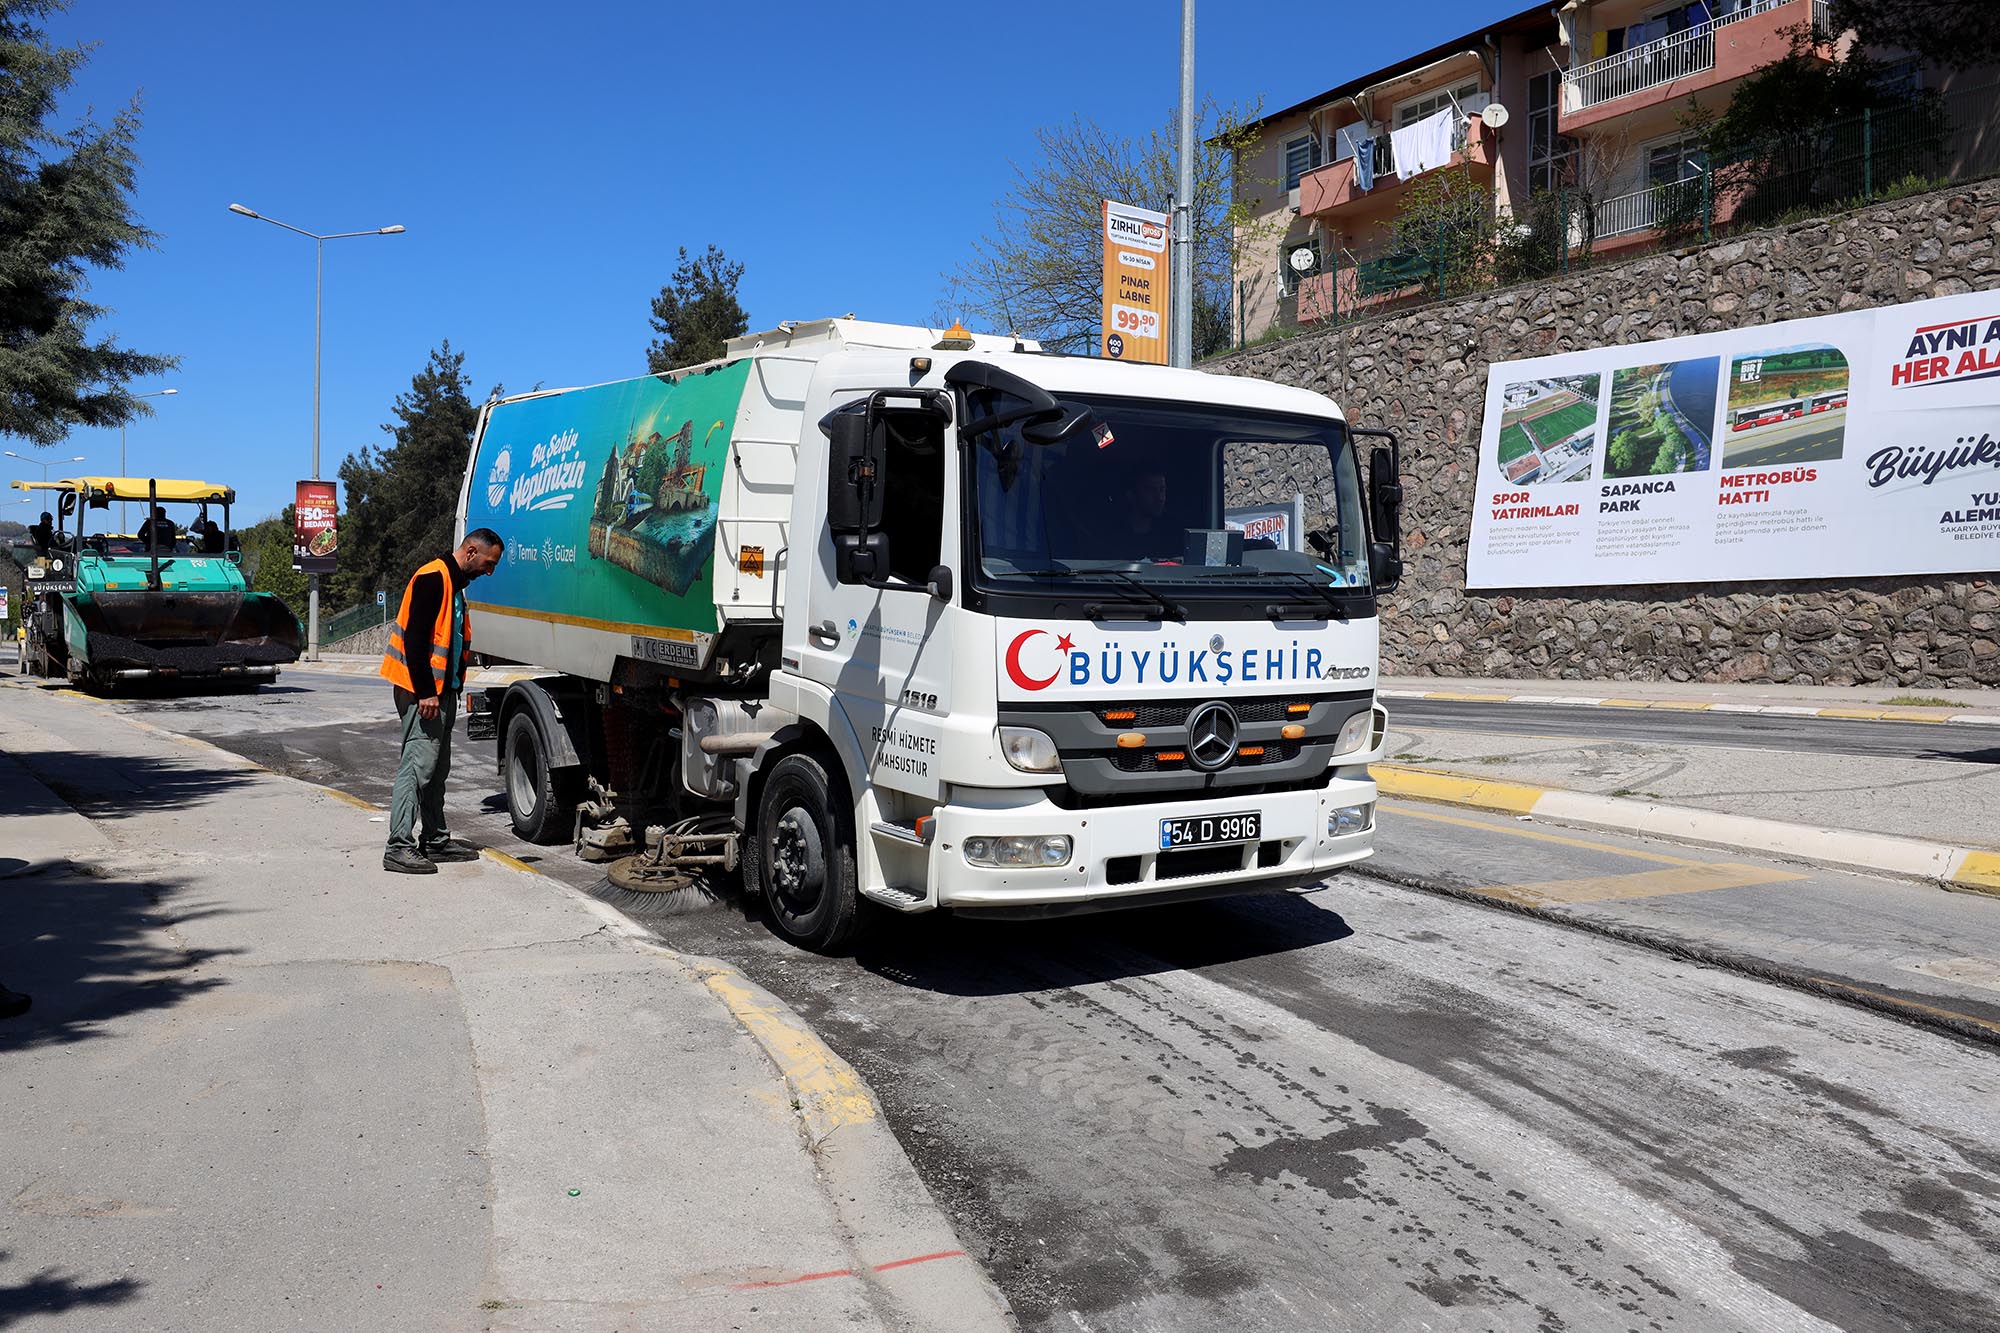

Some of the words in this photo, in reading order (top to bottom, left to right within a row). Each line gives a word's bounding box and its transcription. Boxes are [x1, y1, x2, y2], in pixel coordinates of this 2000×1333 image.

[1111, 218, 1141, 235] ZIRHLI
[1121, 275, 1150, 290] PINAR
[1120, 289, 1150, 304] LABNE
[1109, 339, 1122, 348] 400
[1905, 324, 1978, 358] AYNI
[1110, 346, 1120, 354] GR
[1892, 356, 1950, 386] HER
[1954, 348, 2000, 374] AL
[530, 443, 547, 468] Bu
[546, 428, 578, 466] Şehir
[510, 450, 586, 516] Hepimizin
[1720, 467, 1817, 488] METROBÜS
[1601, 481, 1676, 497] SAPANCA
[1492, 492, 1530, 504] SPOR
[1718, 490, 1770, 505] HATTI
[1971, 492, 2000, 506] YU
[1492, 504, 1580, 520] YATIRIMLARI
[1600, 500, 1640, 513] PARK
[1783, 508, 1808, 516] hayata
[1772, 526, 1788, 534] yeni
[1801, 524, 1827, 532] dönem
[1940, 525, 1978, 534] SAKARYA
[1981, 522, 2000, 531] BÜY
[1954, 532, 1994, 540] BELEDİYE
[518, 544, 538, 560] Temiz
[554, 544, 576, 562] Güzel
[378, 594, 384, 602] D
[1070, 640, 1323, 686] BÜYÜKŞEHİR
[903, 690, 938, 706] 1518
[872, 726, 896, 746] RESMİ
[899, 730, 936, 756] HİZMETE
[878, 751, 928, 778] MAHSUSTUR
[1172, 822, 1193, 843] 54
[1201, 820, 1213, 840] D
[1220, 816, 1256, 839] 9916
